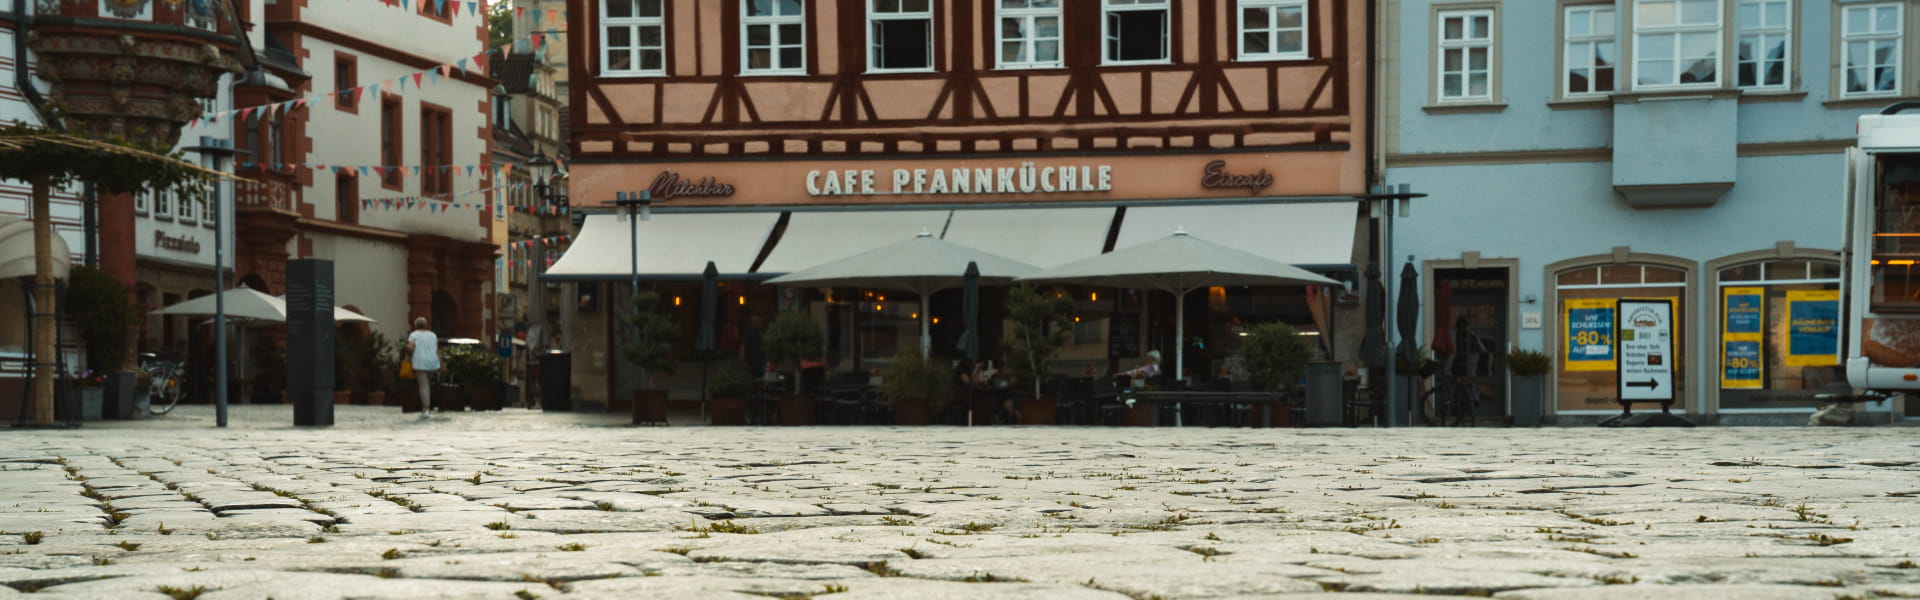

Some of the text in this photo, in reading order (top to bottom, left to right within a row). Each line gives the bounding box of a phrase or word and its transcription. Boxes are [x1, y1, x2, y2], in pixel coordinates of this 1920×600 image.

[649, 171, 735, 199] Milchbar
[806, 162, 1112, 195] CAFE PFANNKÜCHLE
[1201, 160, 1273, 195] Eiscafe
